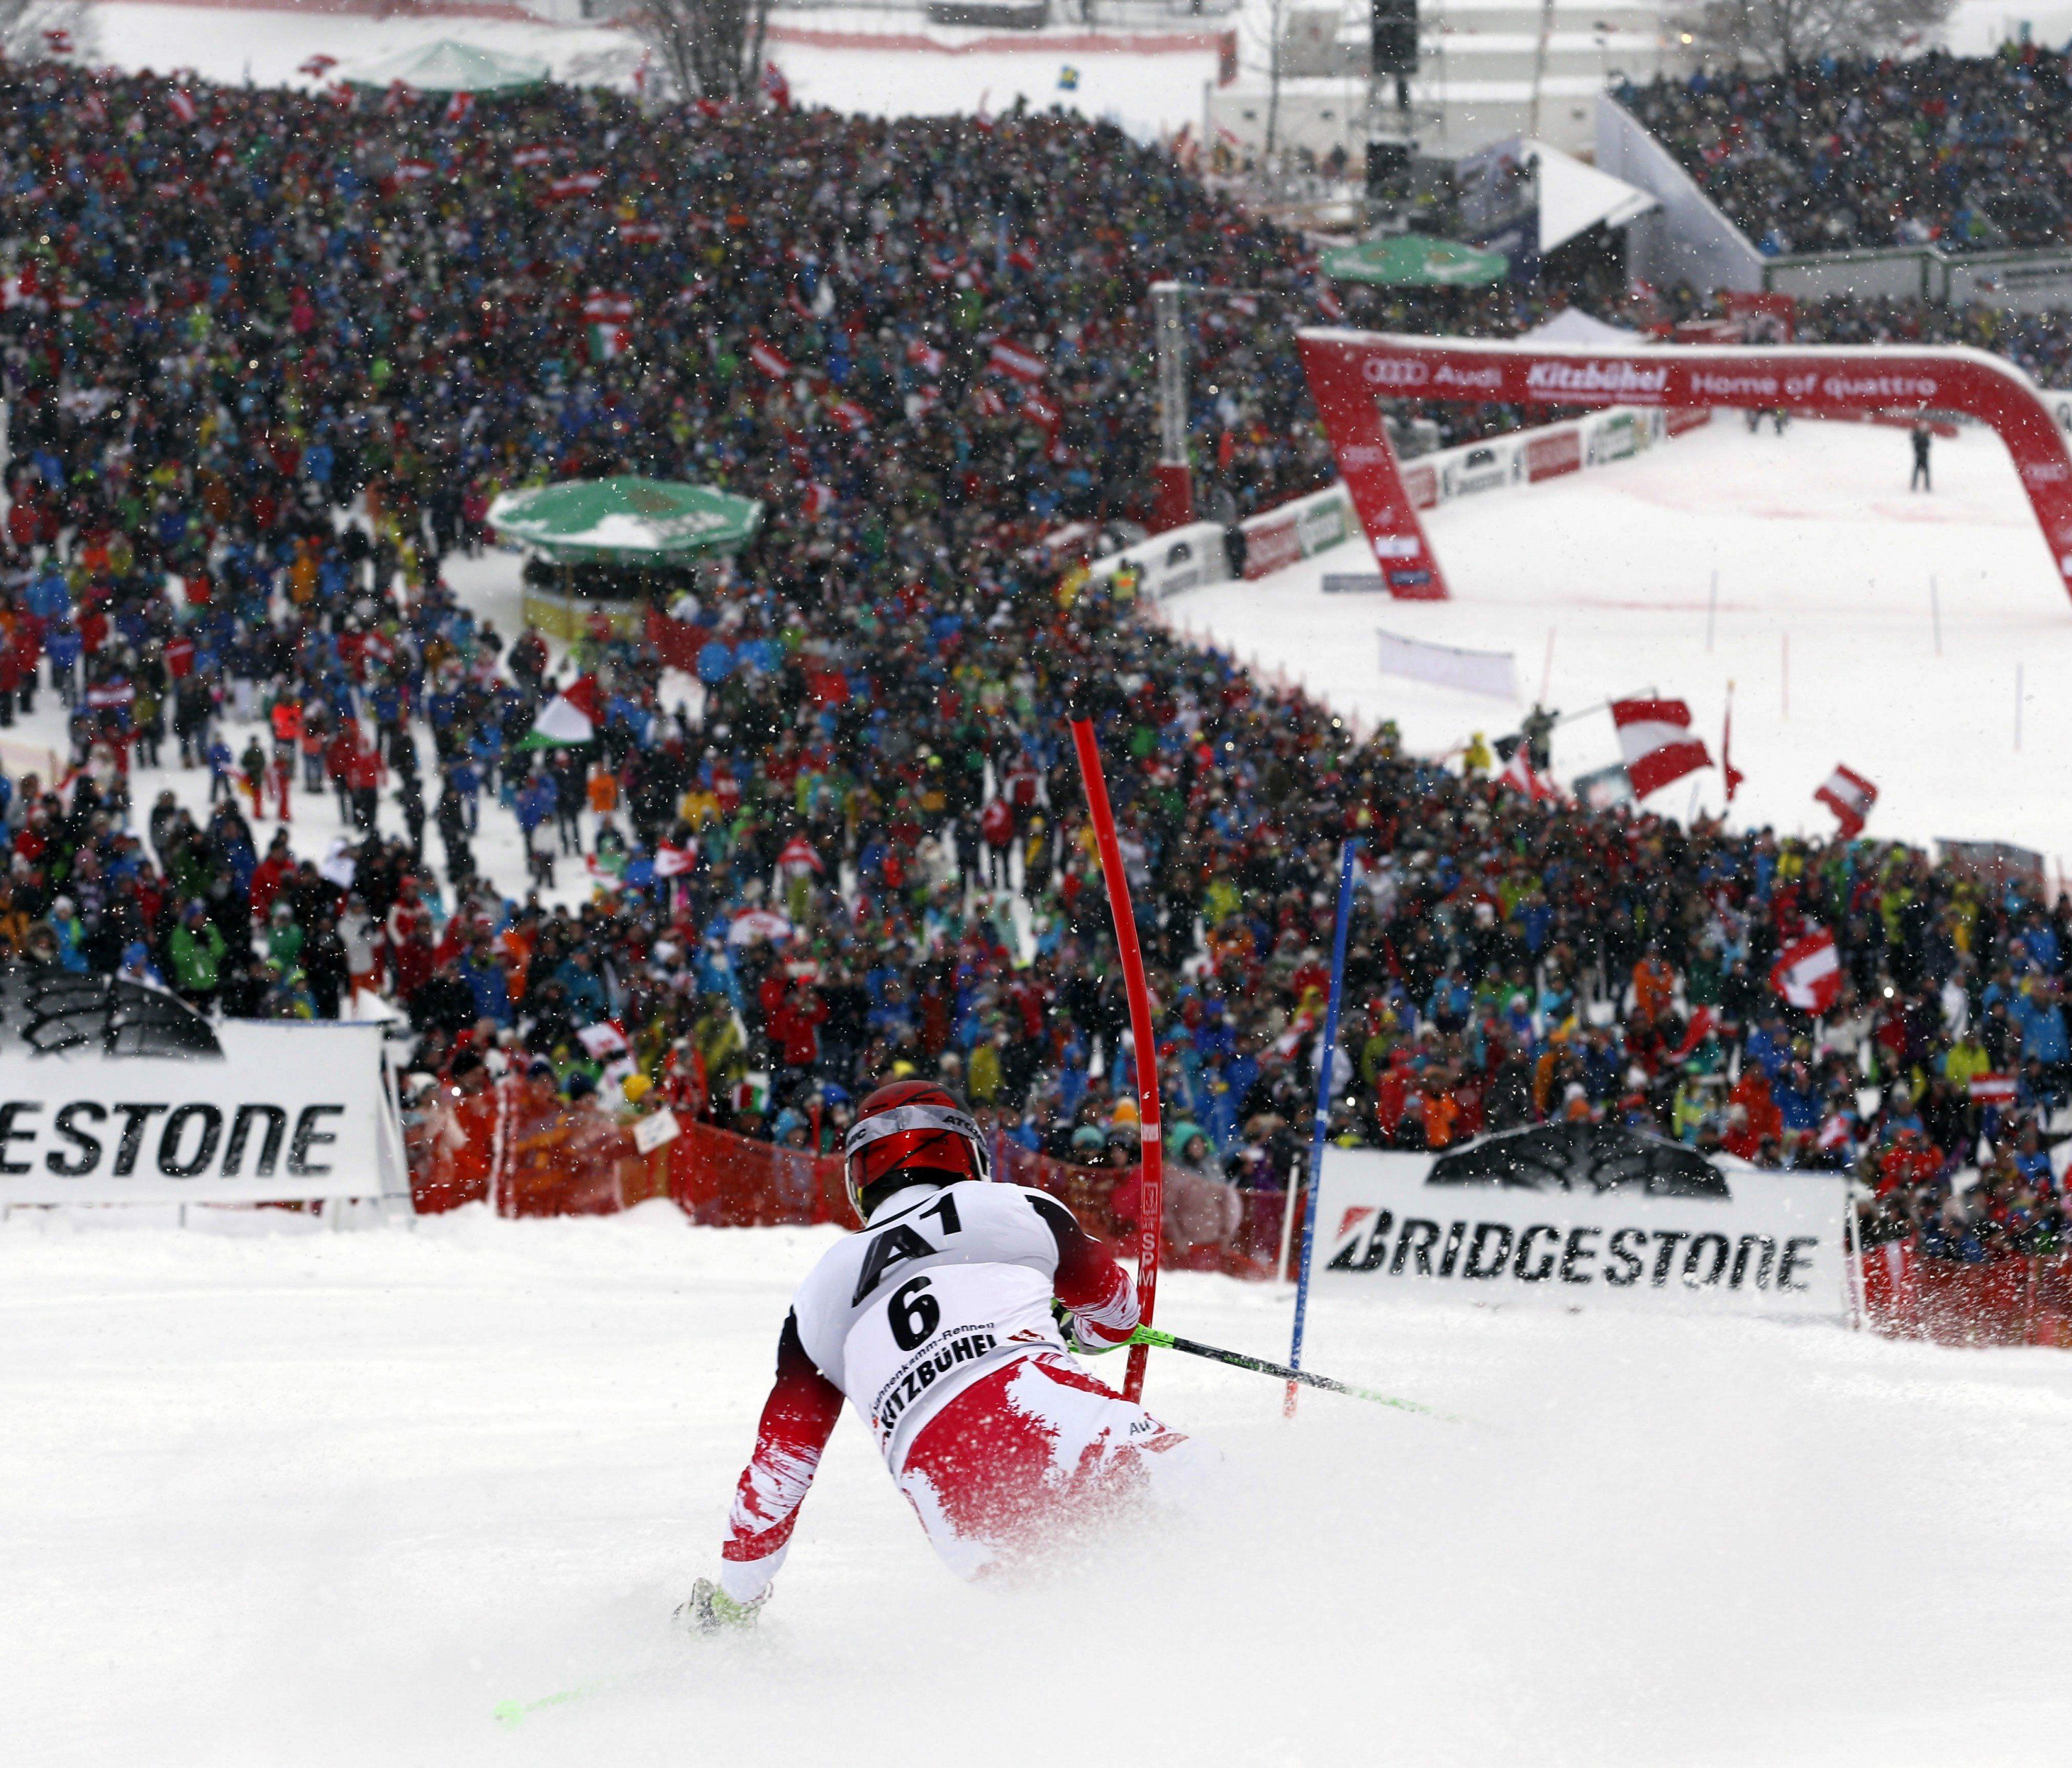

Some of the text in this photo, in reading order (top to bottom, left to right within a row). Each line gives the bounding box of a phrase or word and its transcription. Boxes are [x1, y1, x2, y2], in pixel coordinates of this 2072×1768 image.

[1433, 364, 1502, 388] Audi
[1526, 360, 1667, 390] Kitzbühel
[1690, 373, 1937, 401] Home of quattro
[851, 1192, 962, 1308] A1
[1326, 1207, 1818, 1292] BRIDGESTONE
[887, 1276, 941, 1352] 6
